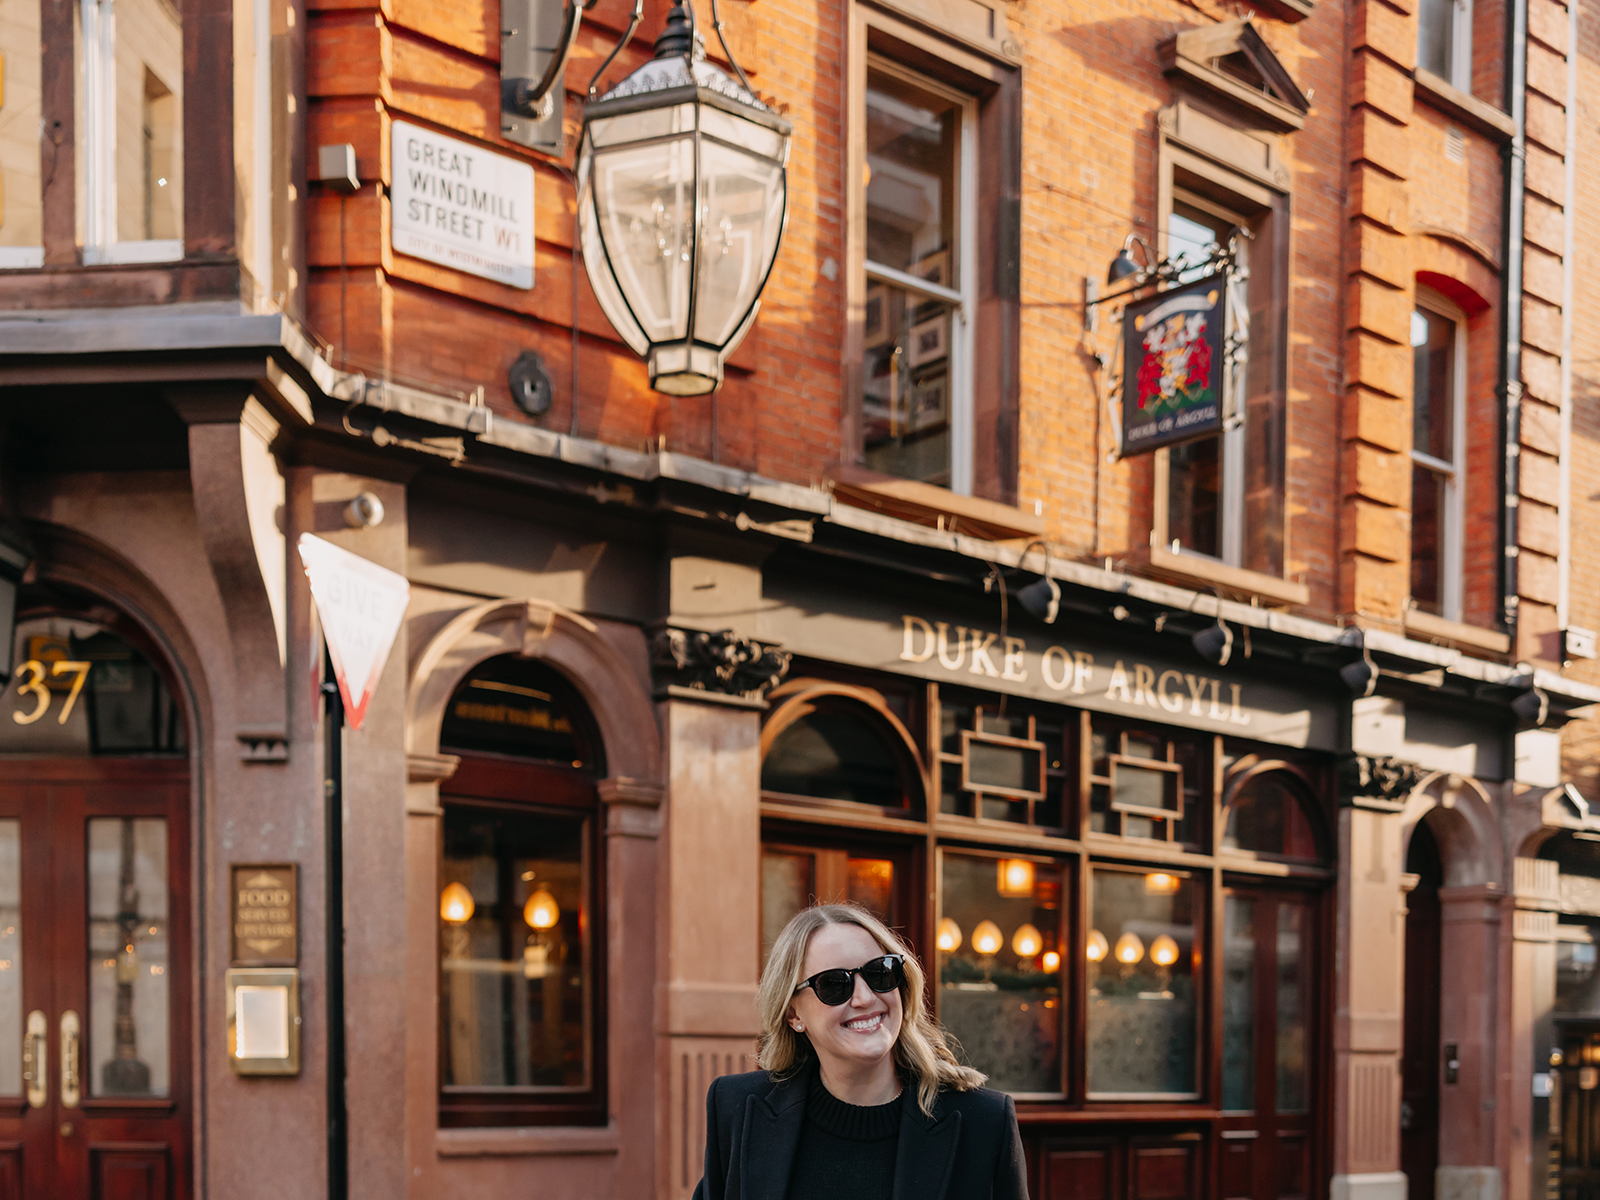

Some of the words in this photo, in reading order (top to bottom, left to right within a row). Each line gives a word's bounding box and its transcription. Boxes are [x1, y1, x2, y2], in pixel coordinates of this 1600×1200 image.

[407, 138, 474, 179] GREAT
[408, 168, 519, 224] WINDMILL
[407, 198, 484, 241] STREET
[494, 225, 521, 254] W1
[407, 236, 429, 250] CITY
[433, 243, 446, 256] OF
[448, 249, 514, 277] WESTMINSTER
[1128, 420, 1159, 442] DUKE
[1158, 416, 1174, 433] OF
[1175, 405, 1217, 429] ARGYLL
[327, 572, 384, 623] GIVE
[340, 619, 374, 652] WAY
[12, 660, 92, 725] 37
[899, 614, 1028, 683] DUKE
[1040, 644, 1095, 695] OF
[1104, 659, 1252, 727] ARGYLL
[238, 889, 292, 908] FOOD
